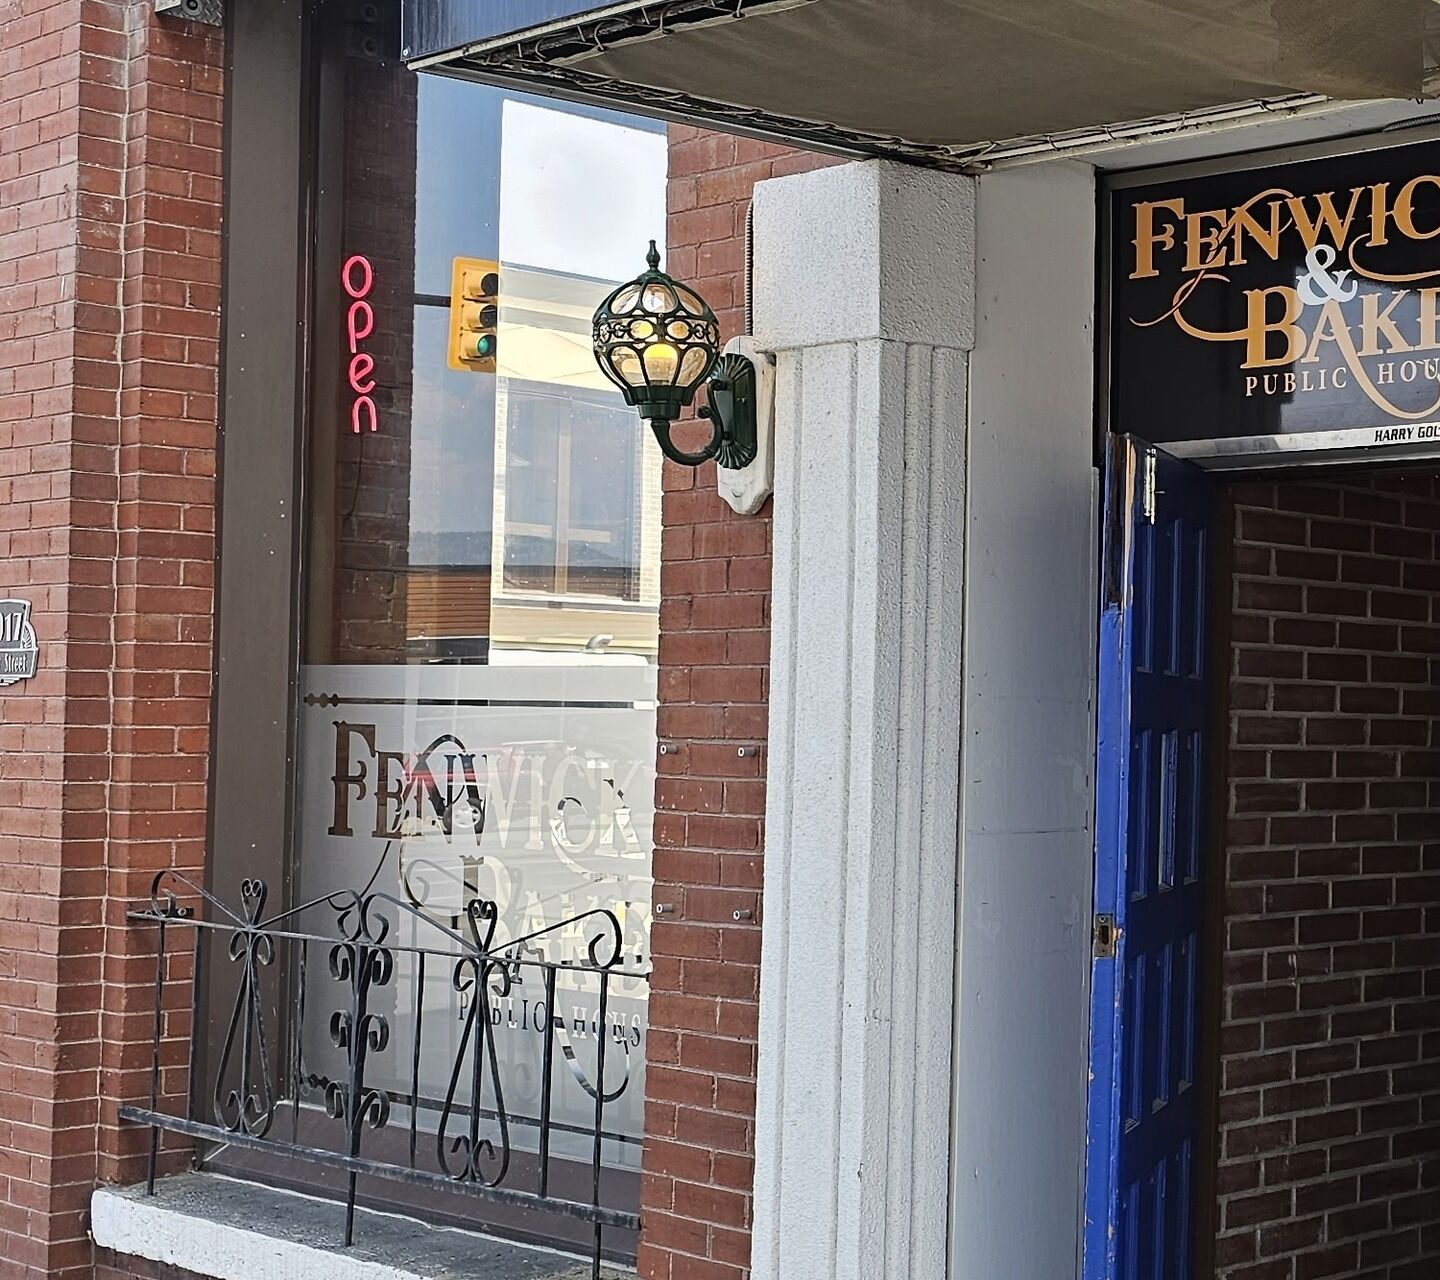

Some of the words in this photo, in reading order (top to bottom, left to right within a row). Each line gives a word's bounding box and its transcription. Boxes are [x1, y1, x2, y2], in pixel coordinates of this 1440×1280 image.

[1296, 244, 1358, 305] &
[1245, 367, 1348, 397] PUBLIC
[1374, 426, 1415, 442] HARRY
[4, 653, 27, 672] Street
[327, 720, 646, 859] FENWICK
[458, 991, 547, 1033] PBLIC
